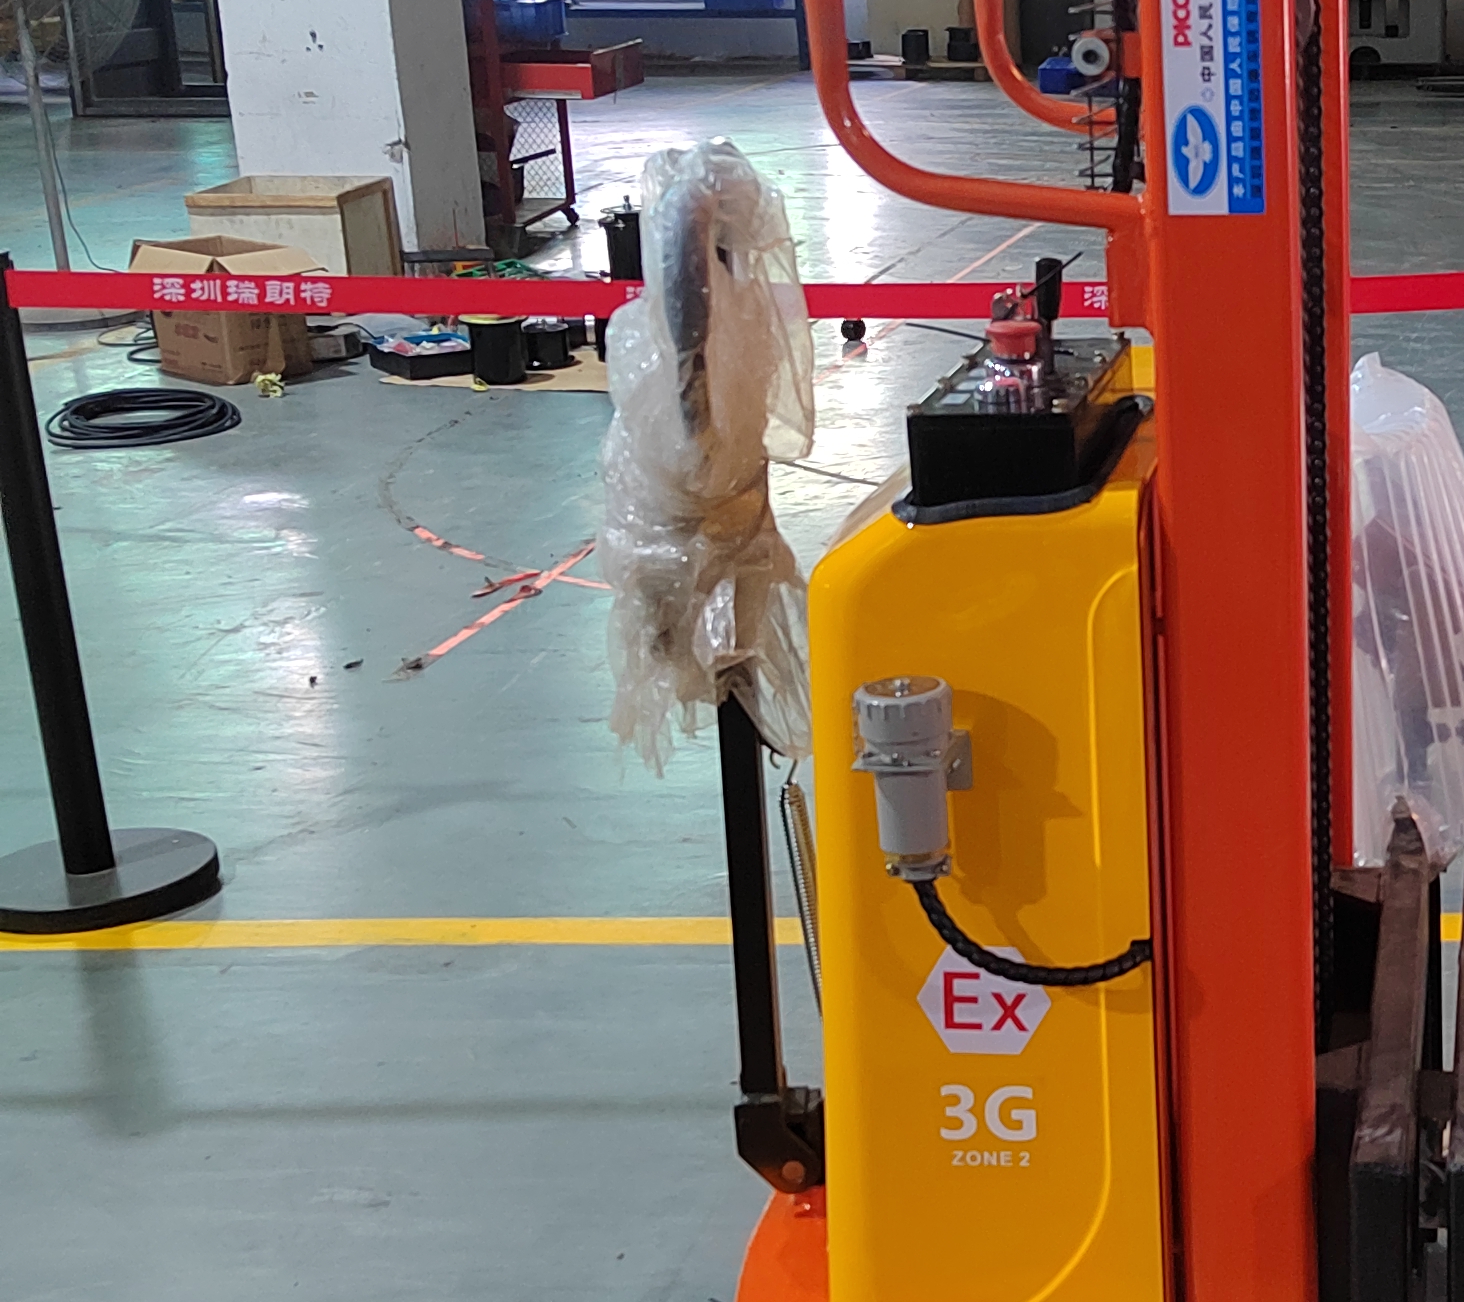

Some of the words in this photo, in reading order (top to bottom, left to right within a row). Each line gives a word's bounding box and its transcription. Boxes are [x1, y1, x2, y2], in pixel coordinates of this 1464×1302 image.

[152, 277, 332, 307] 深圳瑞朗特
[943, 971, 1030, 1032] Ex
[939, 1084, 1038, 1142] 3G
[951, 1150, 1013, 1167] ZONE
[1019, 1152, 1031, 1167] 2
